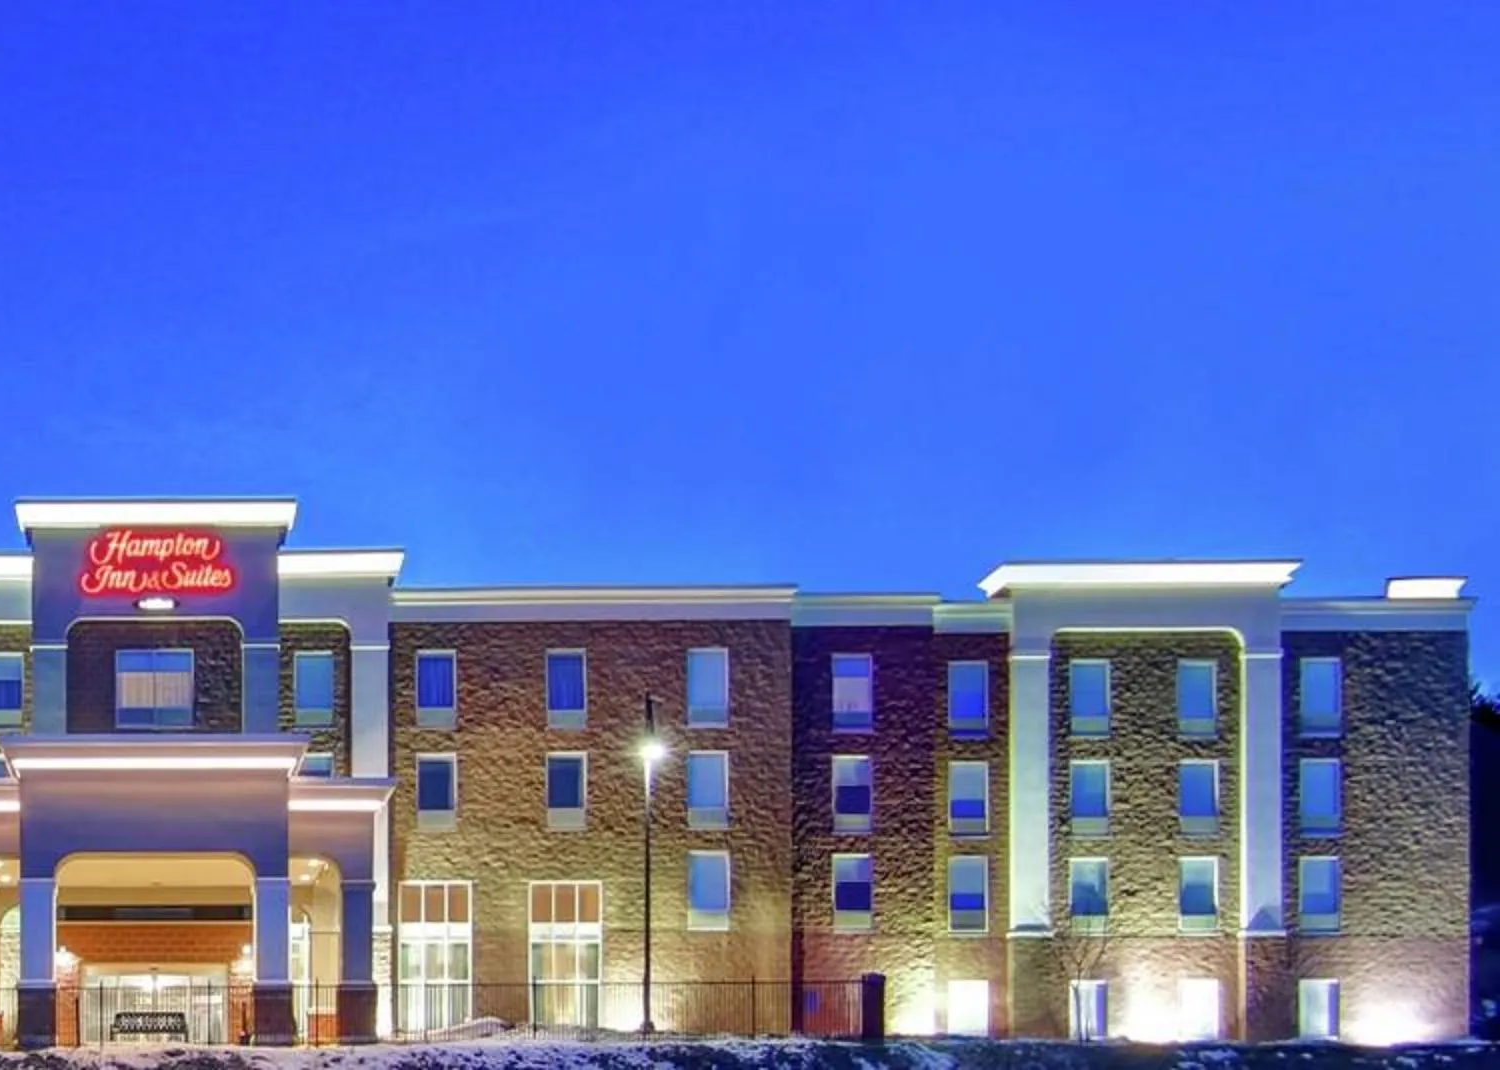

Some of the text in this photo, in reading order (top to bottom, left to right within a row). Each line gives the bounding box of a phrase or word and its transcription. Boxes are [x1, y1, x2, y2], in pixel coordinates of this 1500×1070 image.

[90, 530, 221, 565] Hampton
[81, 561, 232, 592] Inn & Suites
